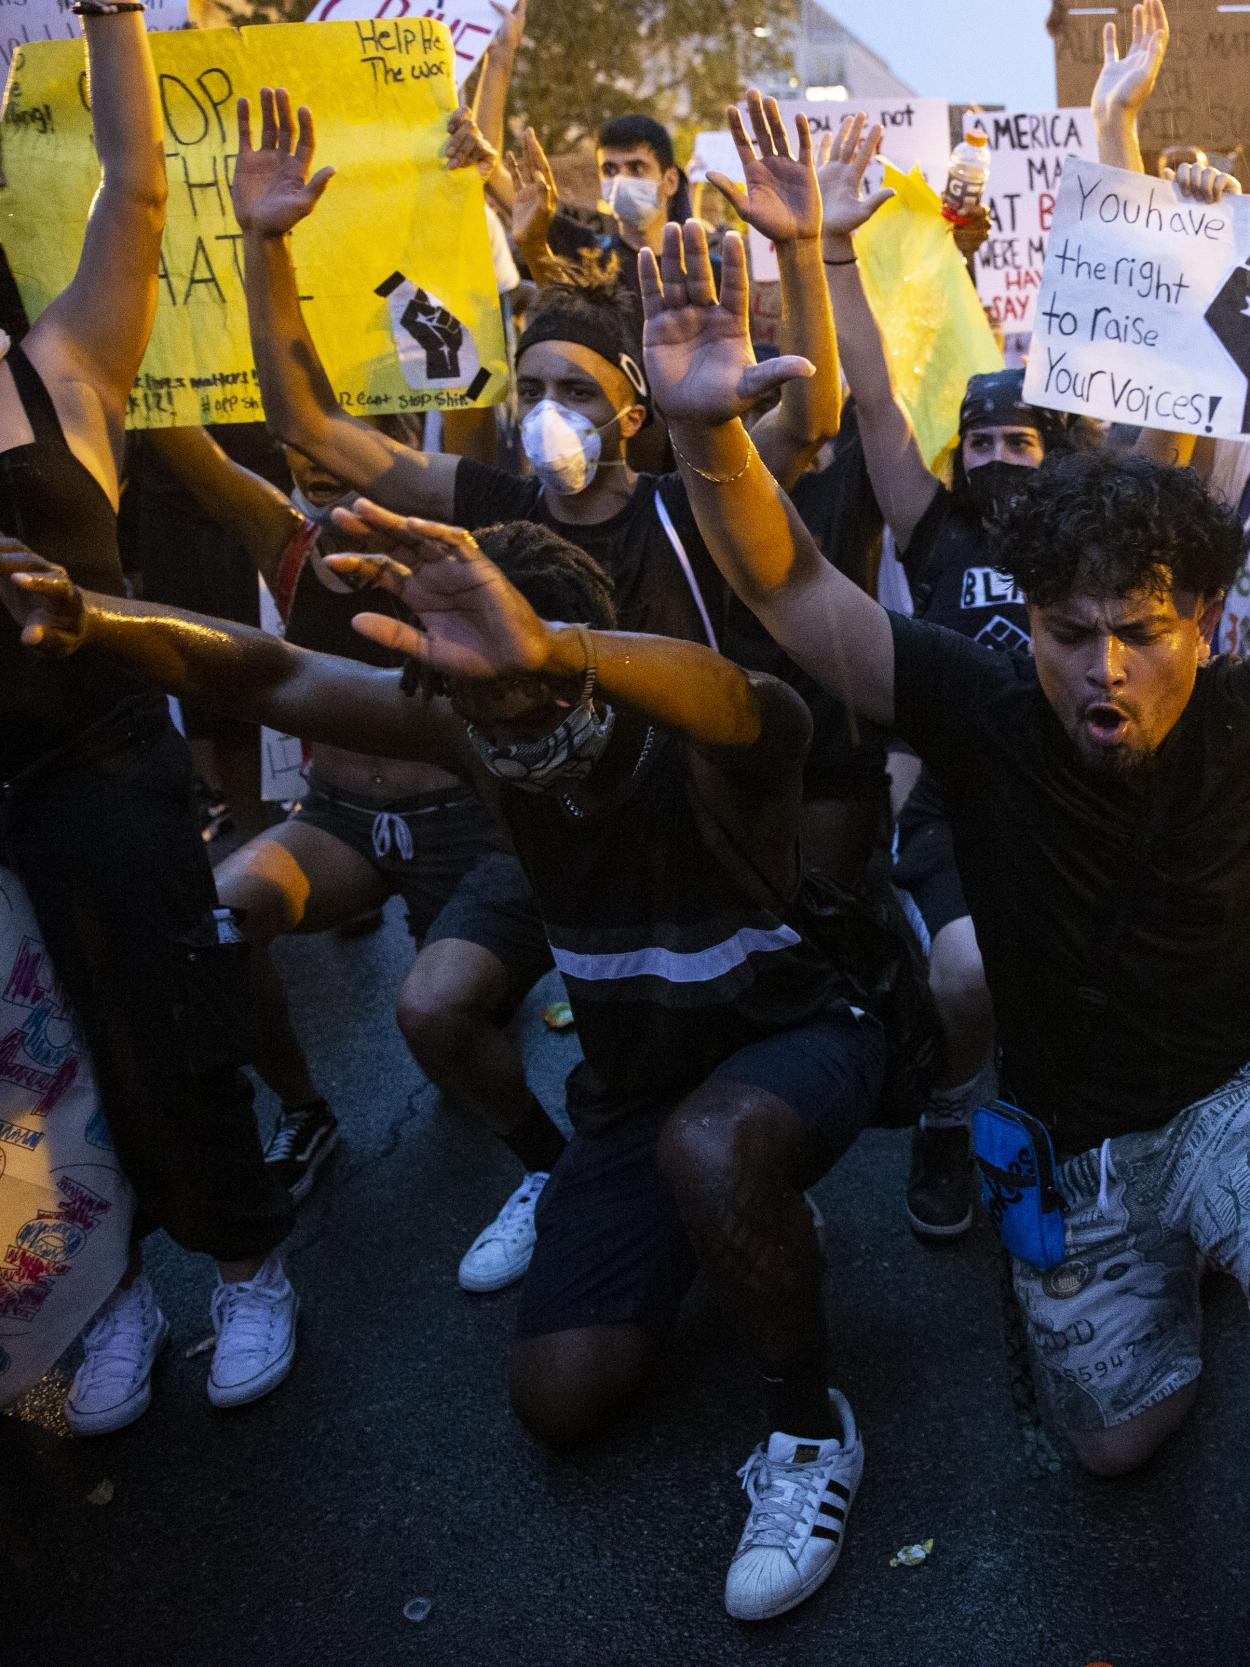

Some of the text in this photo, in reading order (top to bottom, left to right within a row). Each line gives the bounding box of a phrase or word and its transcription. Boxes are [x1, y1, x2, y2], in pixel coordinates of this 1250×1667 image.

[355, 20, 415, 54] Help
[361, 56, 404, 84] The
[881, 104, 914, 127] not
[974, 114, 1082, 150] AMERICA
[1042, 291, 1159, 347] to raise
[964, 570, 1019, 606] BL
